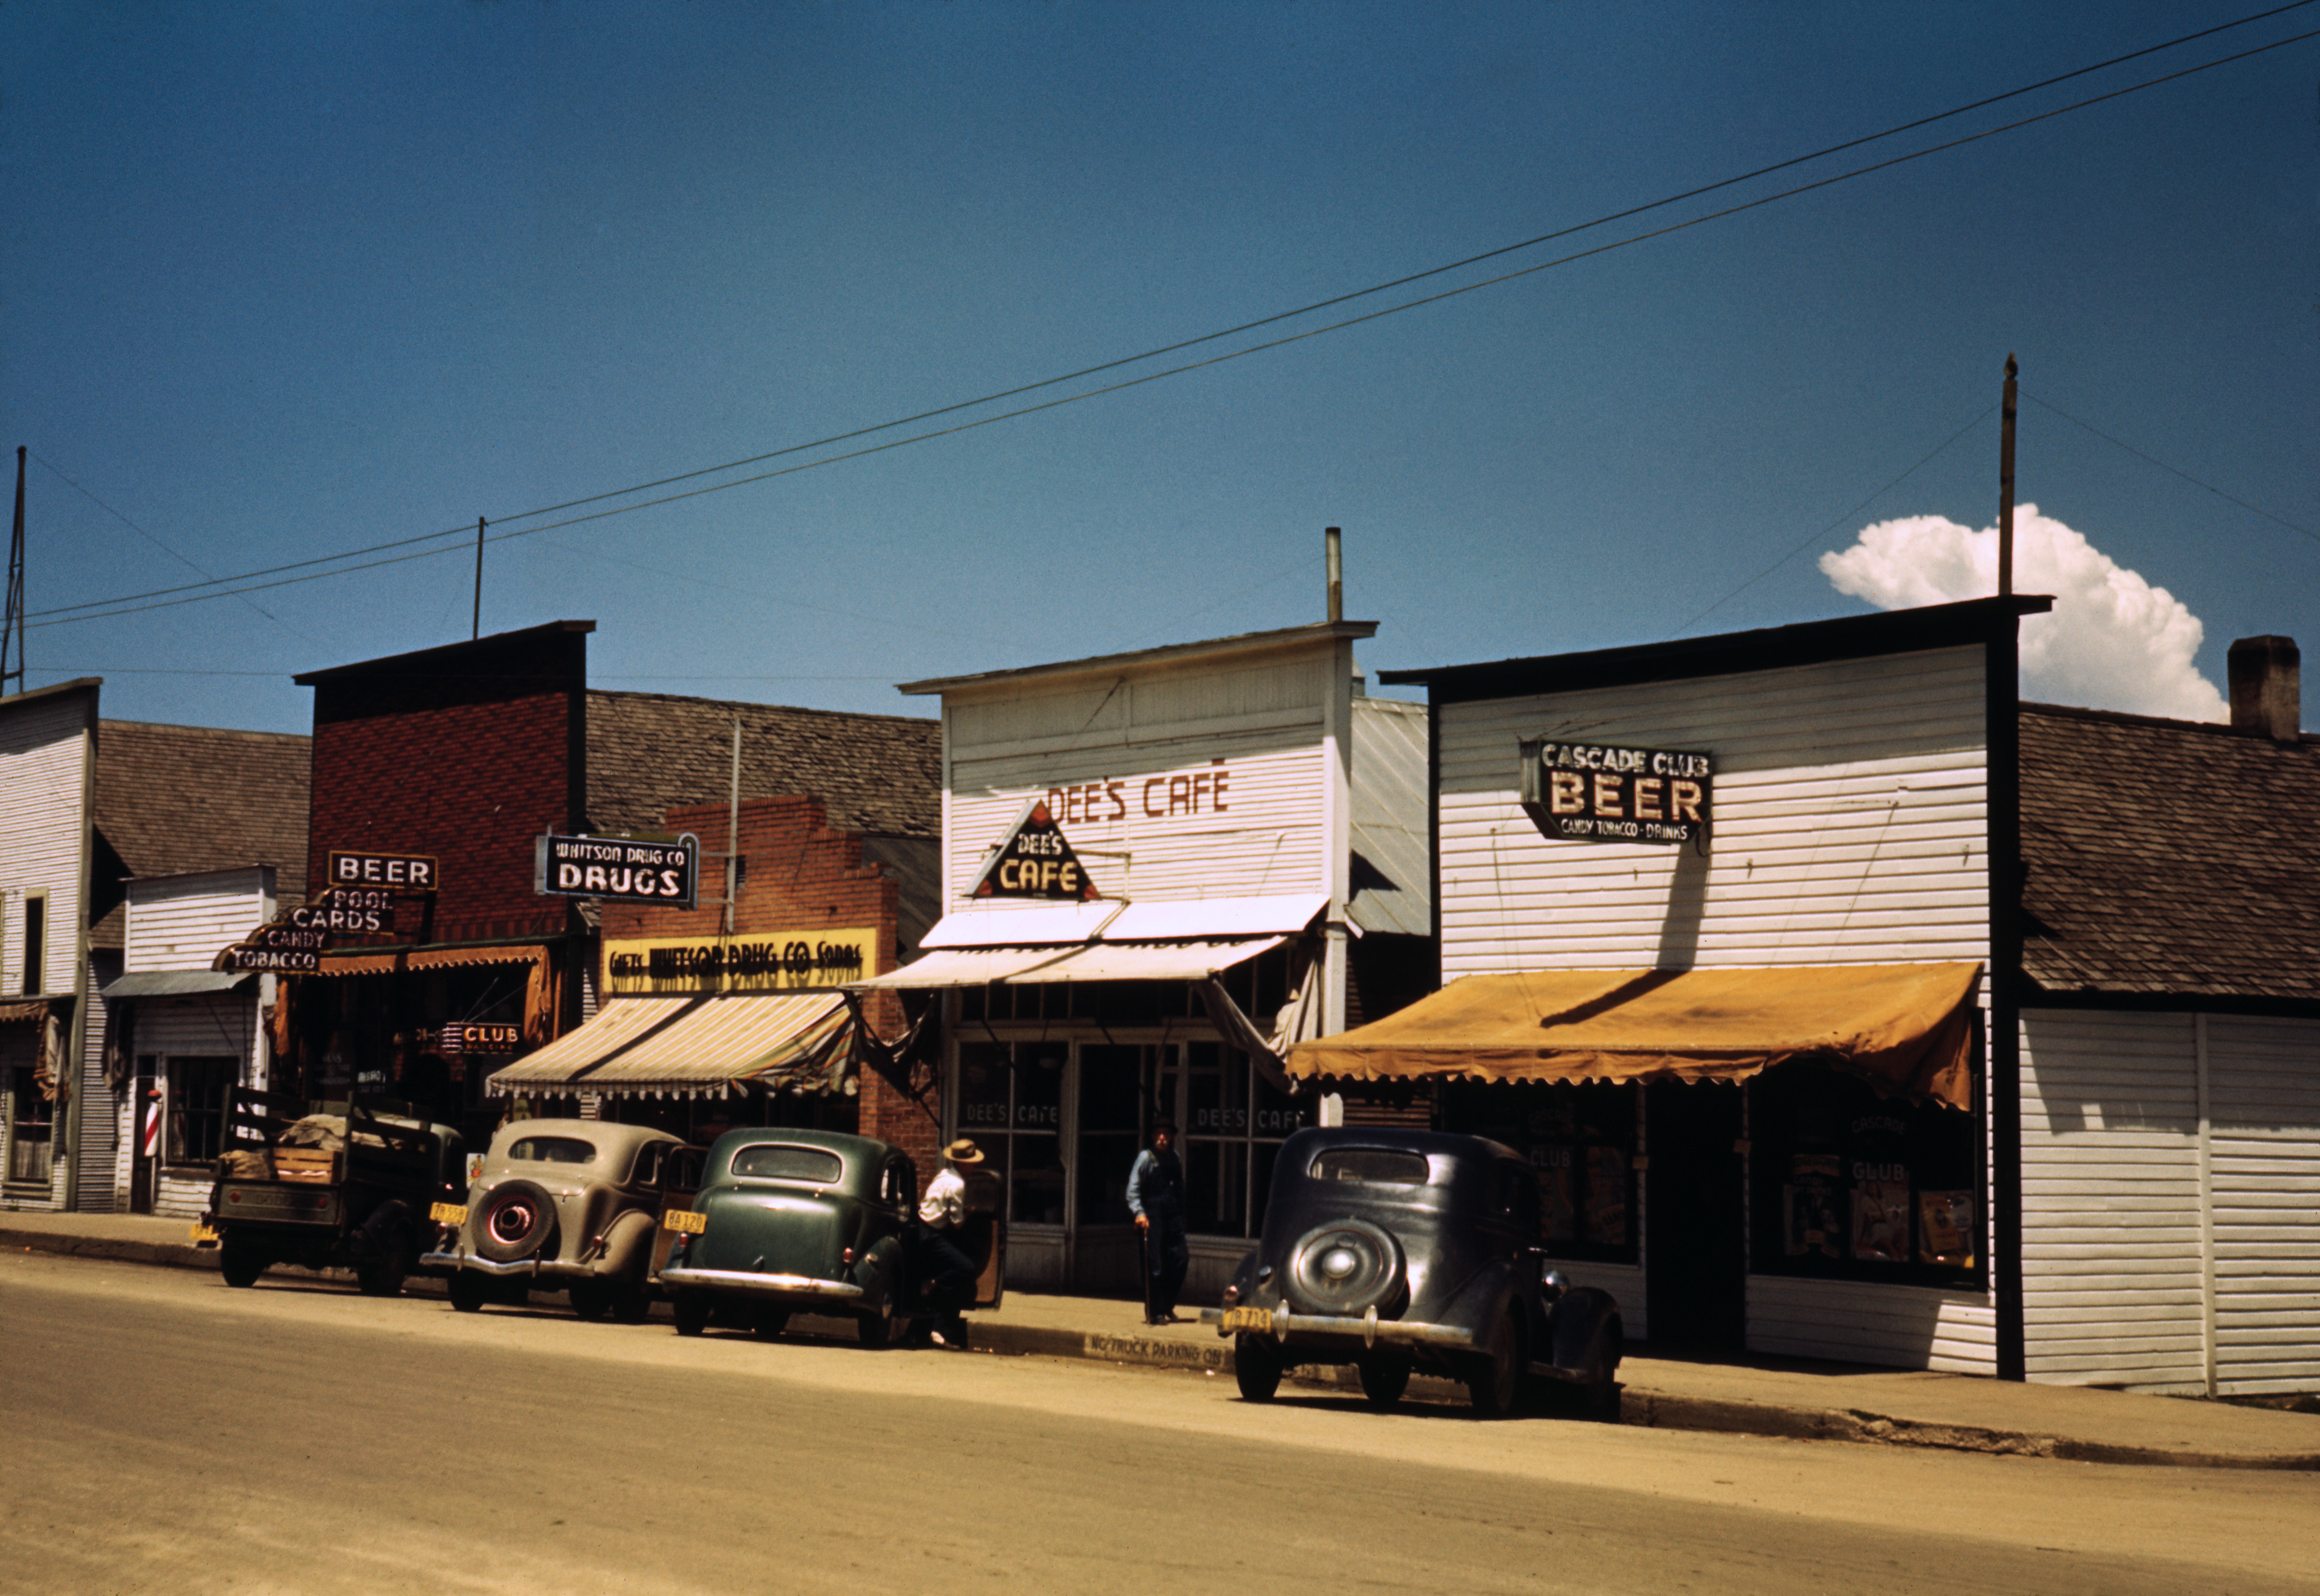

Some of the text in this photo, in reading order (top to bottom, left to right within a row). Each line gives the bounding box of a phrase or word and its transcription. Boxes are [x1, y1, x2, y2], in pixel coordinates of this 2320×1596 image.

[1542, 744, 1709, 777] CASCADE CLUB
[1048, 776, 1126, 825] DEE'S
[1551, 770, 1703, 823] BEER
[1561, 819, 1688, 840] CANDY TOBACCO DRINKS
[556, 842, 685, 867] WHITSON DRUG CO
[1017, 830, 1063, 856] DEE'S
[339, 857, 429, 884] BEER
[559, 863, 680, 896] DRUGS
[1000, 859, 1078, 892] CAFE
[334, 890, 393, 910] POOL
[293, 908, 380, 931] CARDS
[267, 930, 326, 948] CANDY
[232, 951, 316, 969] TOBACCO
[728, 942, 778, 976] DRUG
[783, 941, 810, 974] CO
[464, 1027, 518, 1042] CLUB
[967, 1102, 1058, 1123] DEE'S CAFE
[1197, 1107, 1246, 1128] DEE'S
[1851, 1115, 1907, 1135] CASCADE
[1531, 1149, 1571, 1168] CLUB
[1110, 1337, 1149, 1357] TRUCK
[1152, 1343, 1200, 1361] PARKING
